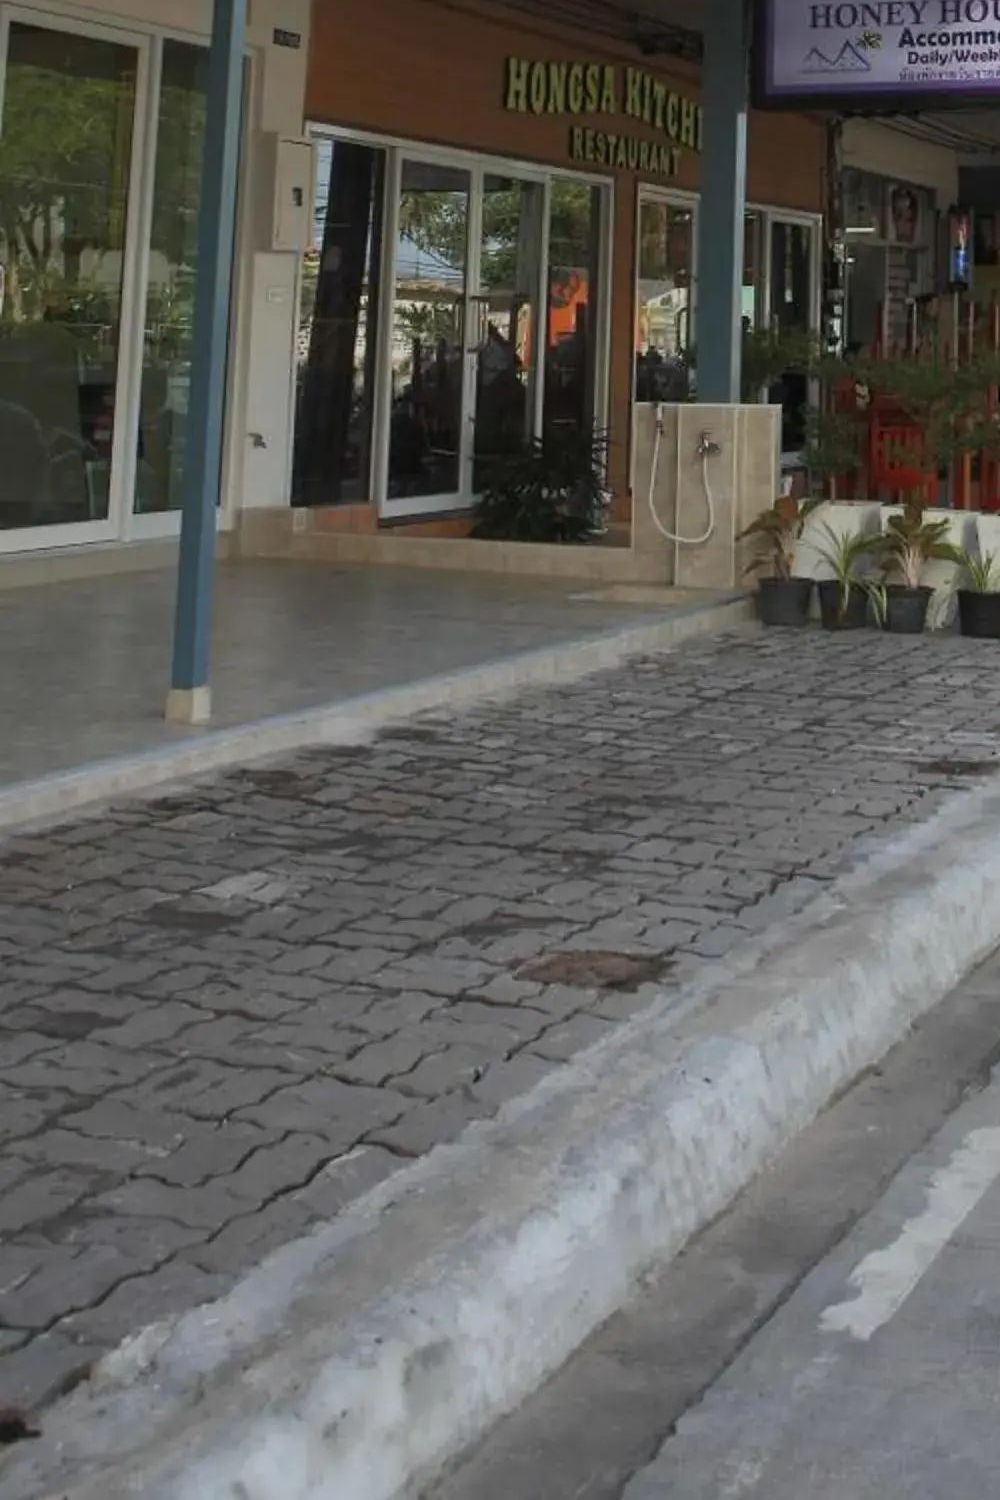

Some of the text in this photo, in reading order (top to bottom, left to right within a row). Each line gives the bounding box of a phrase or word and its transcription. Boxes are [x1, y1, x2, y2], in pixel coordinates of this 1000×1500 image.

[809, 1, 928, 29] HONEY
[506, 56, 616, 115] HONGSA
[570, 126, 681, 176] RESTAURANT
